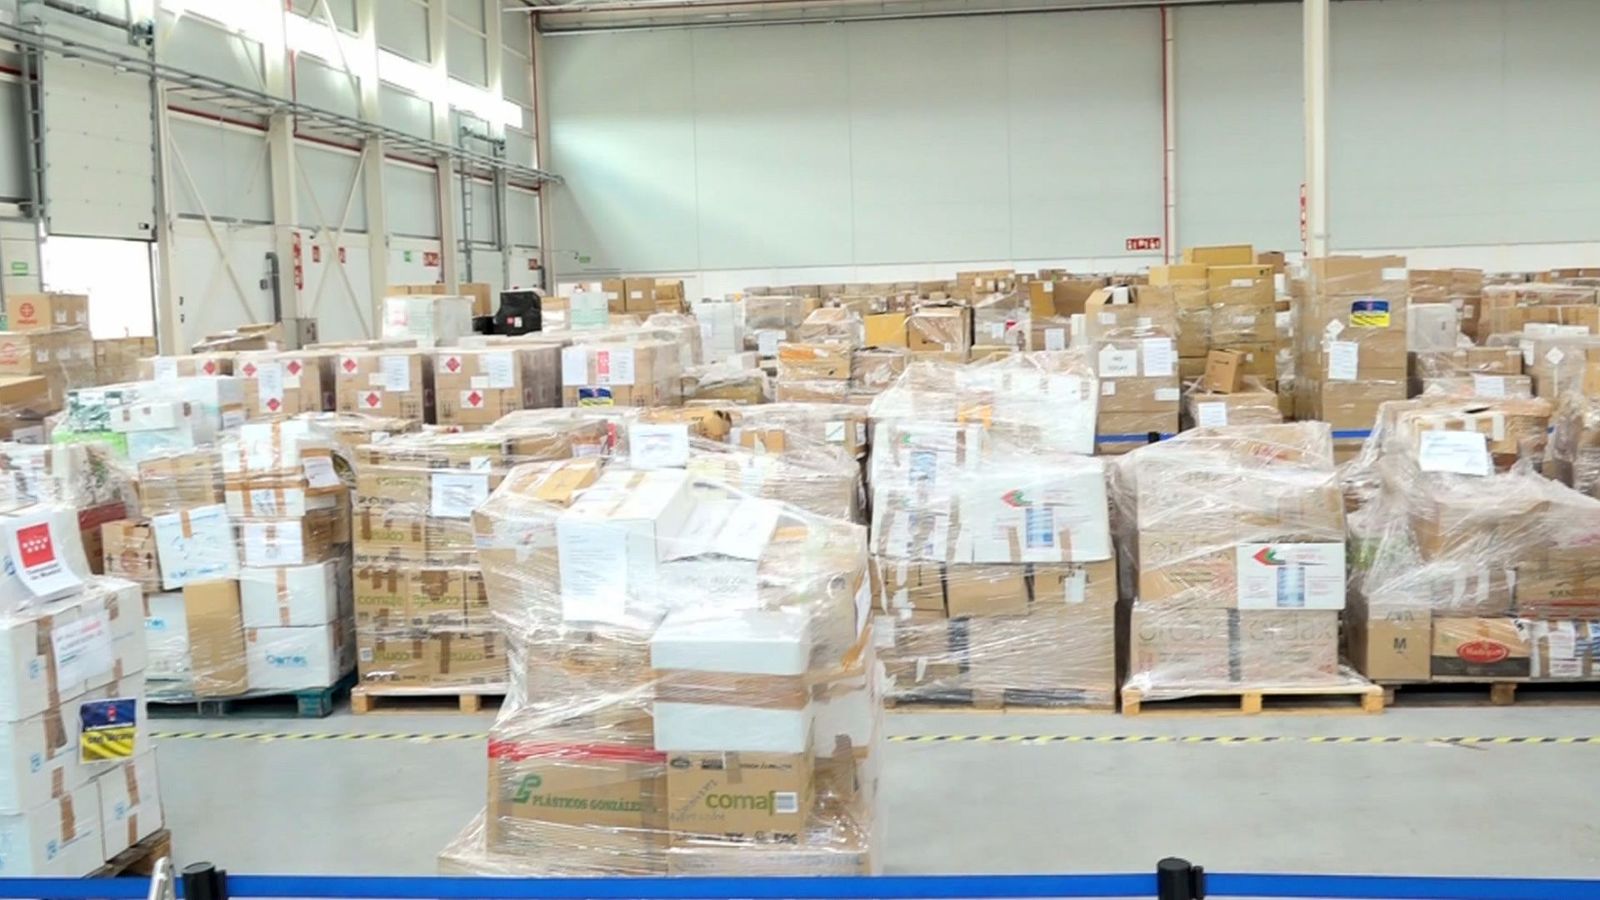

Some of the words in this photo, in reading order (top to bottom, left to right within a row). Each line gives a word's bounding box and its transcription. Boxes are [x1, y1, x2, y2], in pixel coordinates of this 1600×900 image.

[1393, 637, 1408, 650] M
[532, 793, 589, 811] PLÁSTICOS
[705, 789, 777, 817] comaf
